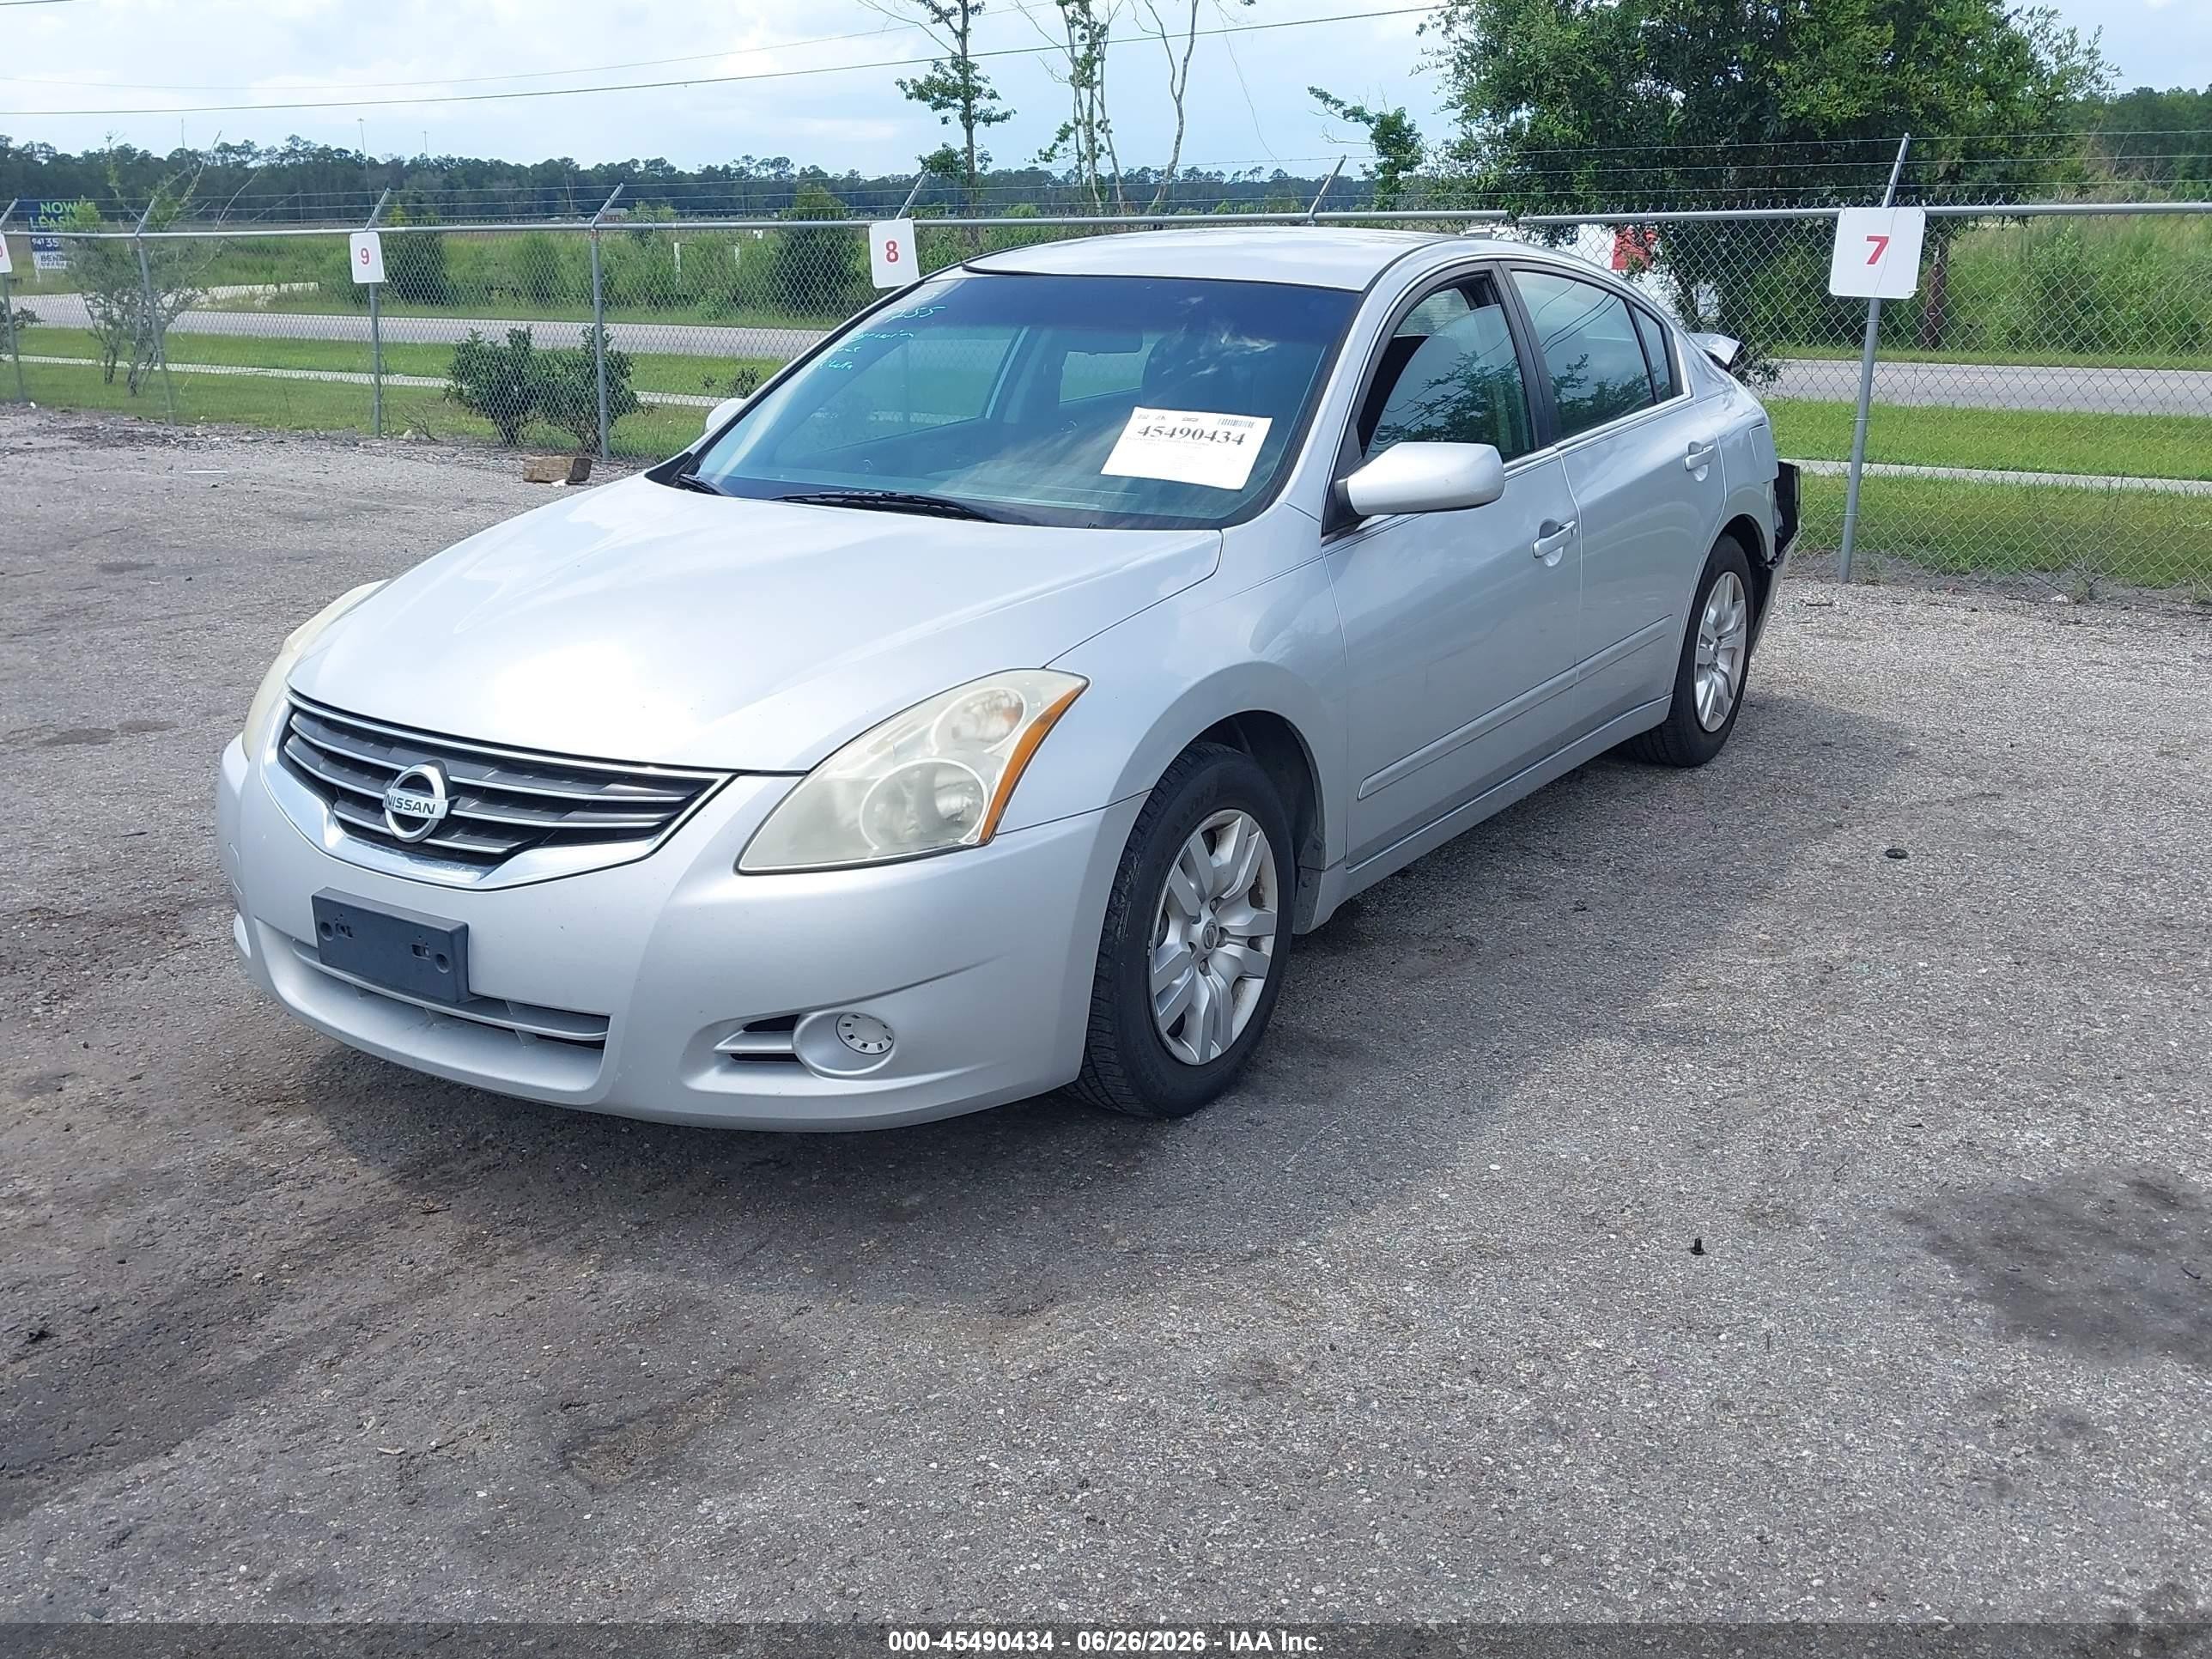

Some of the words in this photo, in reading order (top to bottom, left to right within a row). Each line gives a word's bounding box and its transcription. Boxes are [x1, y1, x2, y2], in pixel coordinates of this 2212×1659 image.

[40, 202, 77, 214] NOW
[360, 247, 370, 265] 9
[885, 240, 899, 263] 8
[1866, 235, 1890, 265] 7
[1137, 425, 1246, 446] 45490434
[385, 793, 436, 815] NISSAN
